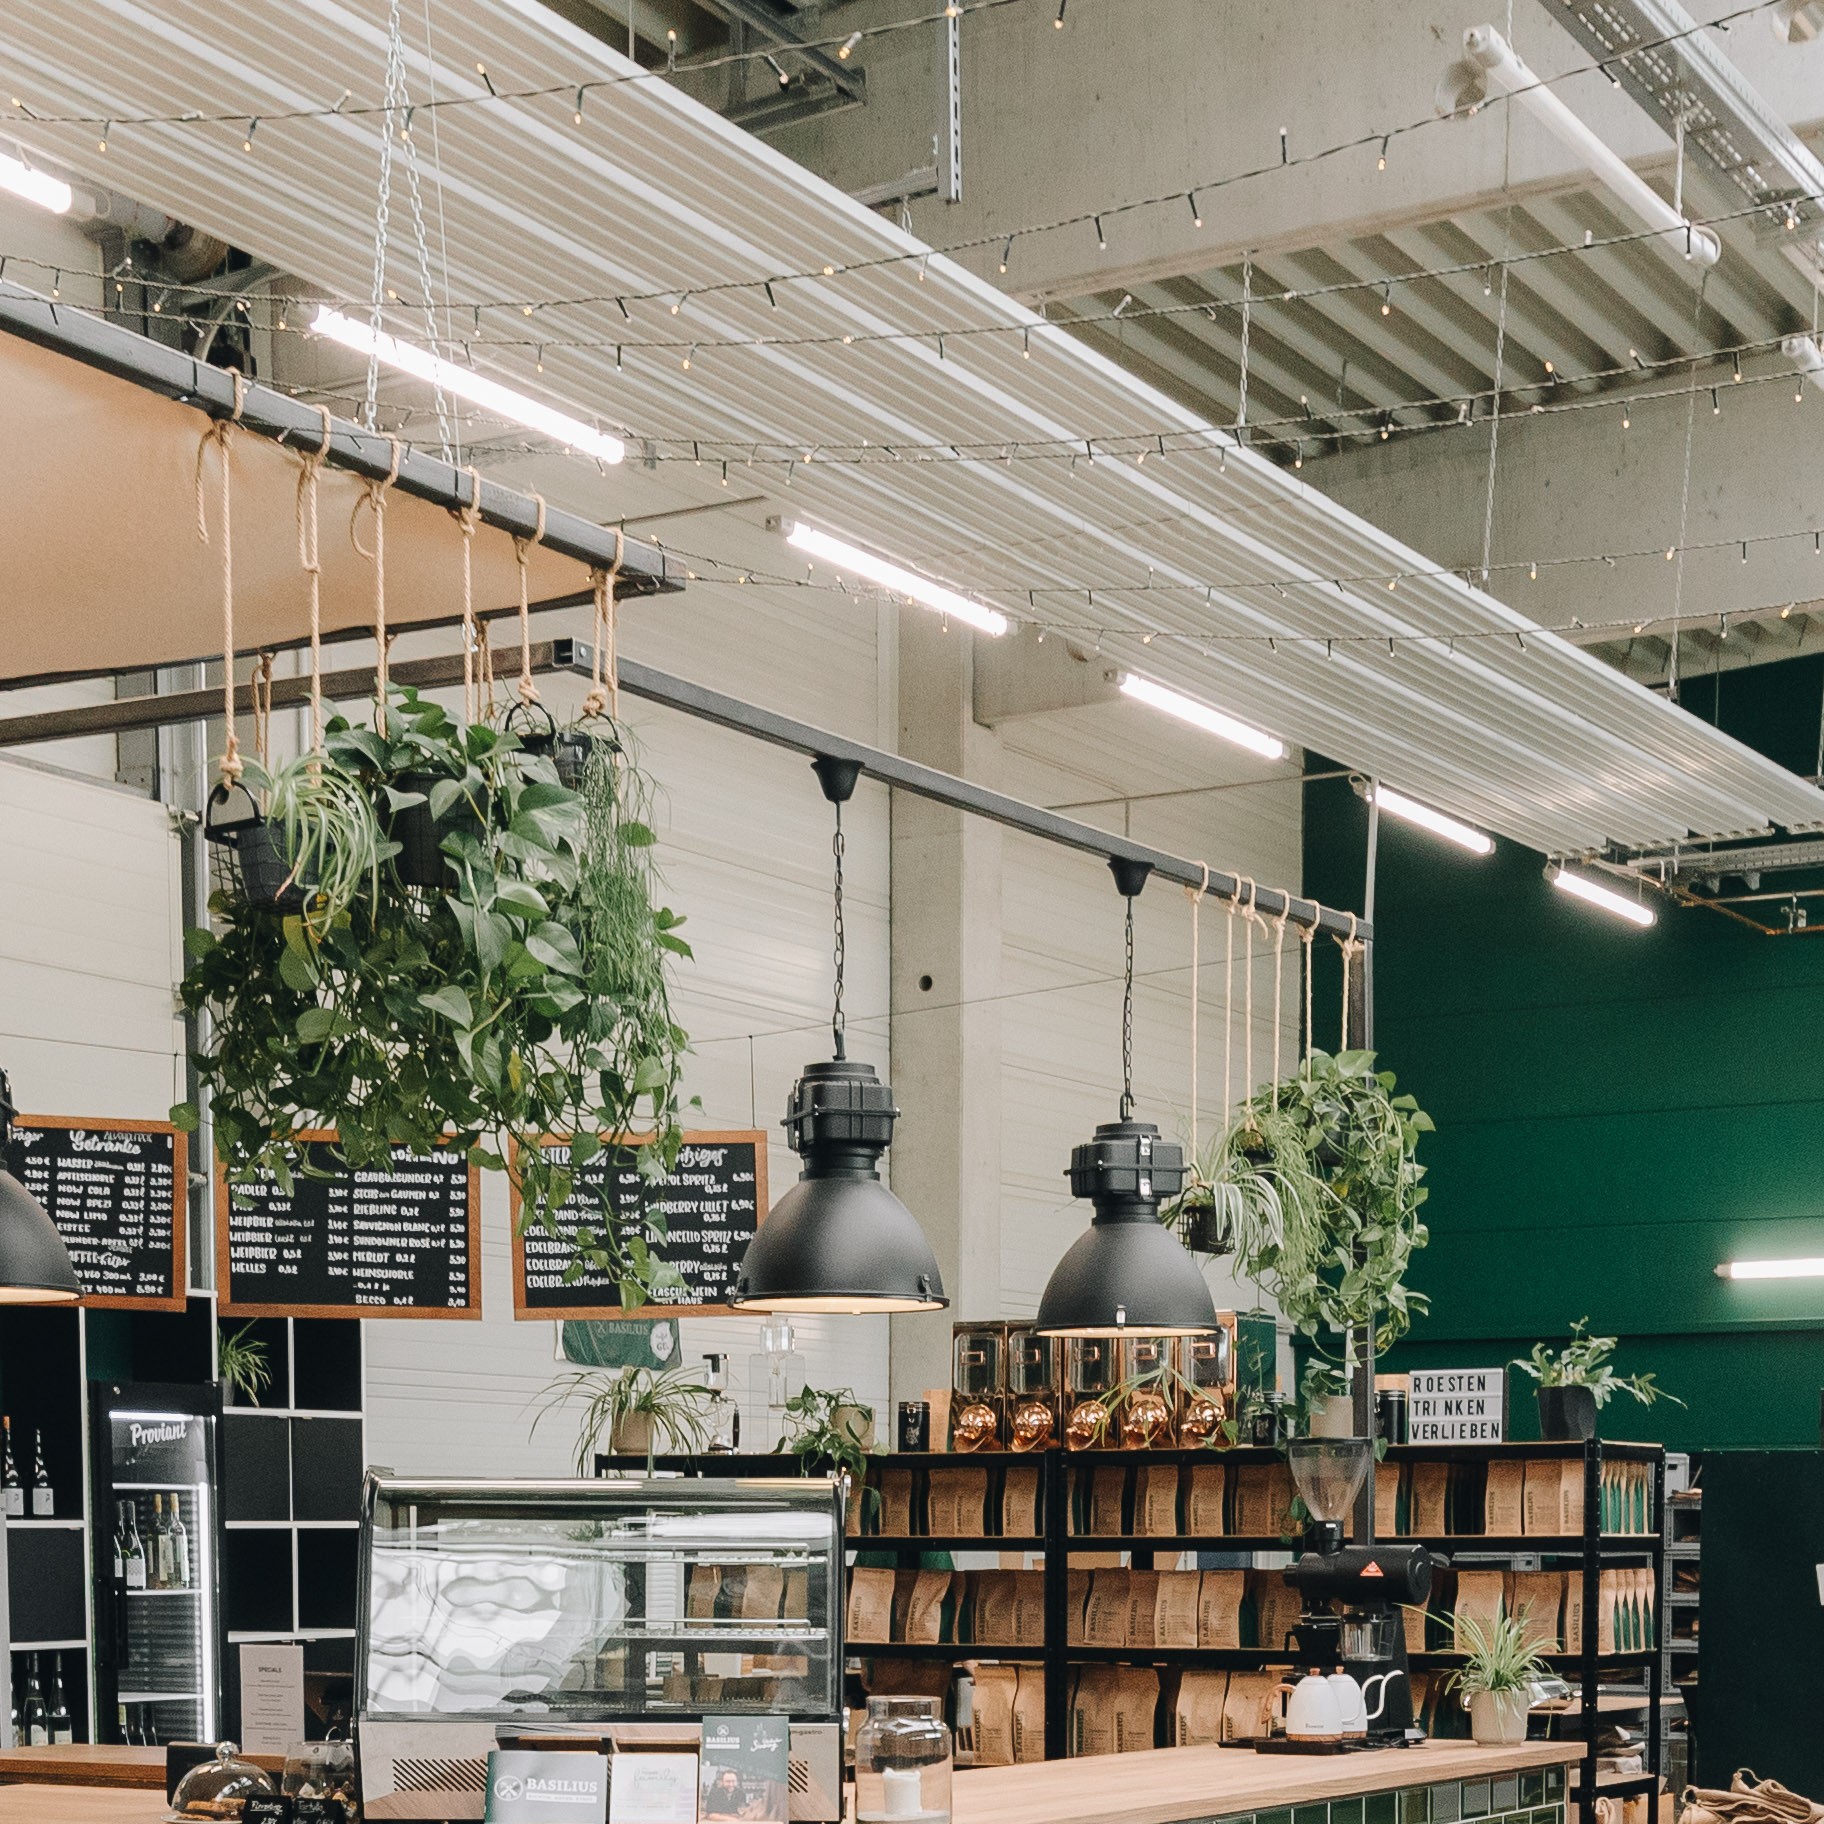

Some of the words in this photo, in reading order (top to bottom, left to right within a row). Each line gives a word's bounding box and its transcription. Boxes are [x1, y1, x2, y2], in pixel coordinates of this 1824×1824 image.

[57, 1157, 94, 1169] WASSER
[354, 1171, 432, 1184] GRAUBURGUNDER
[683, 1173, 716, 1185] SPRITZ
[58, 1184, 83, 1194] NOW
[87, 1185, 110, 1195] COLA
[390, 1188, 426, 1200] GAUMEN
[56, 1197, 80, 1206] NOW
[700, 1200, 729, 1212] LILLET
[56, 1209, 79, 1220] NOW
[83, 1211, 107, 1221] LIMO
[57, 1223, 91, 1233] EISTEE
[353, 1219, 402, 1232] SAUVIGNON
[402, 1221, 430, 1233] BLANC
[353, 1235, 408, 1248] SUNDOWNER
[701, 1231, 732, 1243] SPRITZ
[352, 1251, 391, 1264] MERLOT
[231, 1262, 267, 1274] HELLES
[355, 1295, 386, 1305] SECCO
[609, 1322, 649, 1335] BASILIUS
[1414, 1376, 1485, 1392] ROESTEN
[1414, 1400, 1484, 1415] TRINKEN
[129, 1421, 187, 1447] Proviant
[1412, 1423, 1499, 1439] VERLIEBEN
[1090, 1596, 1101, 1632] BASILIUS
[1130, 1599, 1138, 1636] BASILIUS
[1159, 1600, 1167, 1637] BASILIUS
[1203, 1599, 1211, 1638] BASILIUS
[1015, 1710, 1024, 1753] BASILIUS
[527, 1778, 598, 1793] BASILIUS
